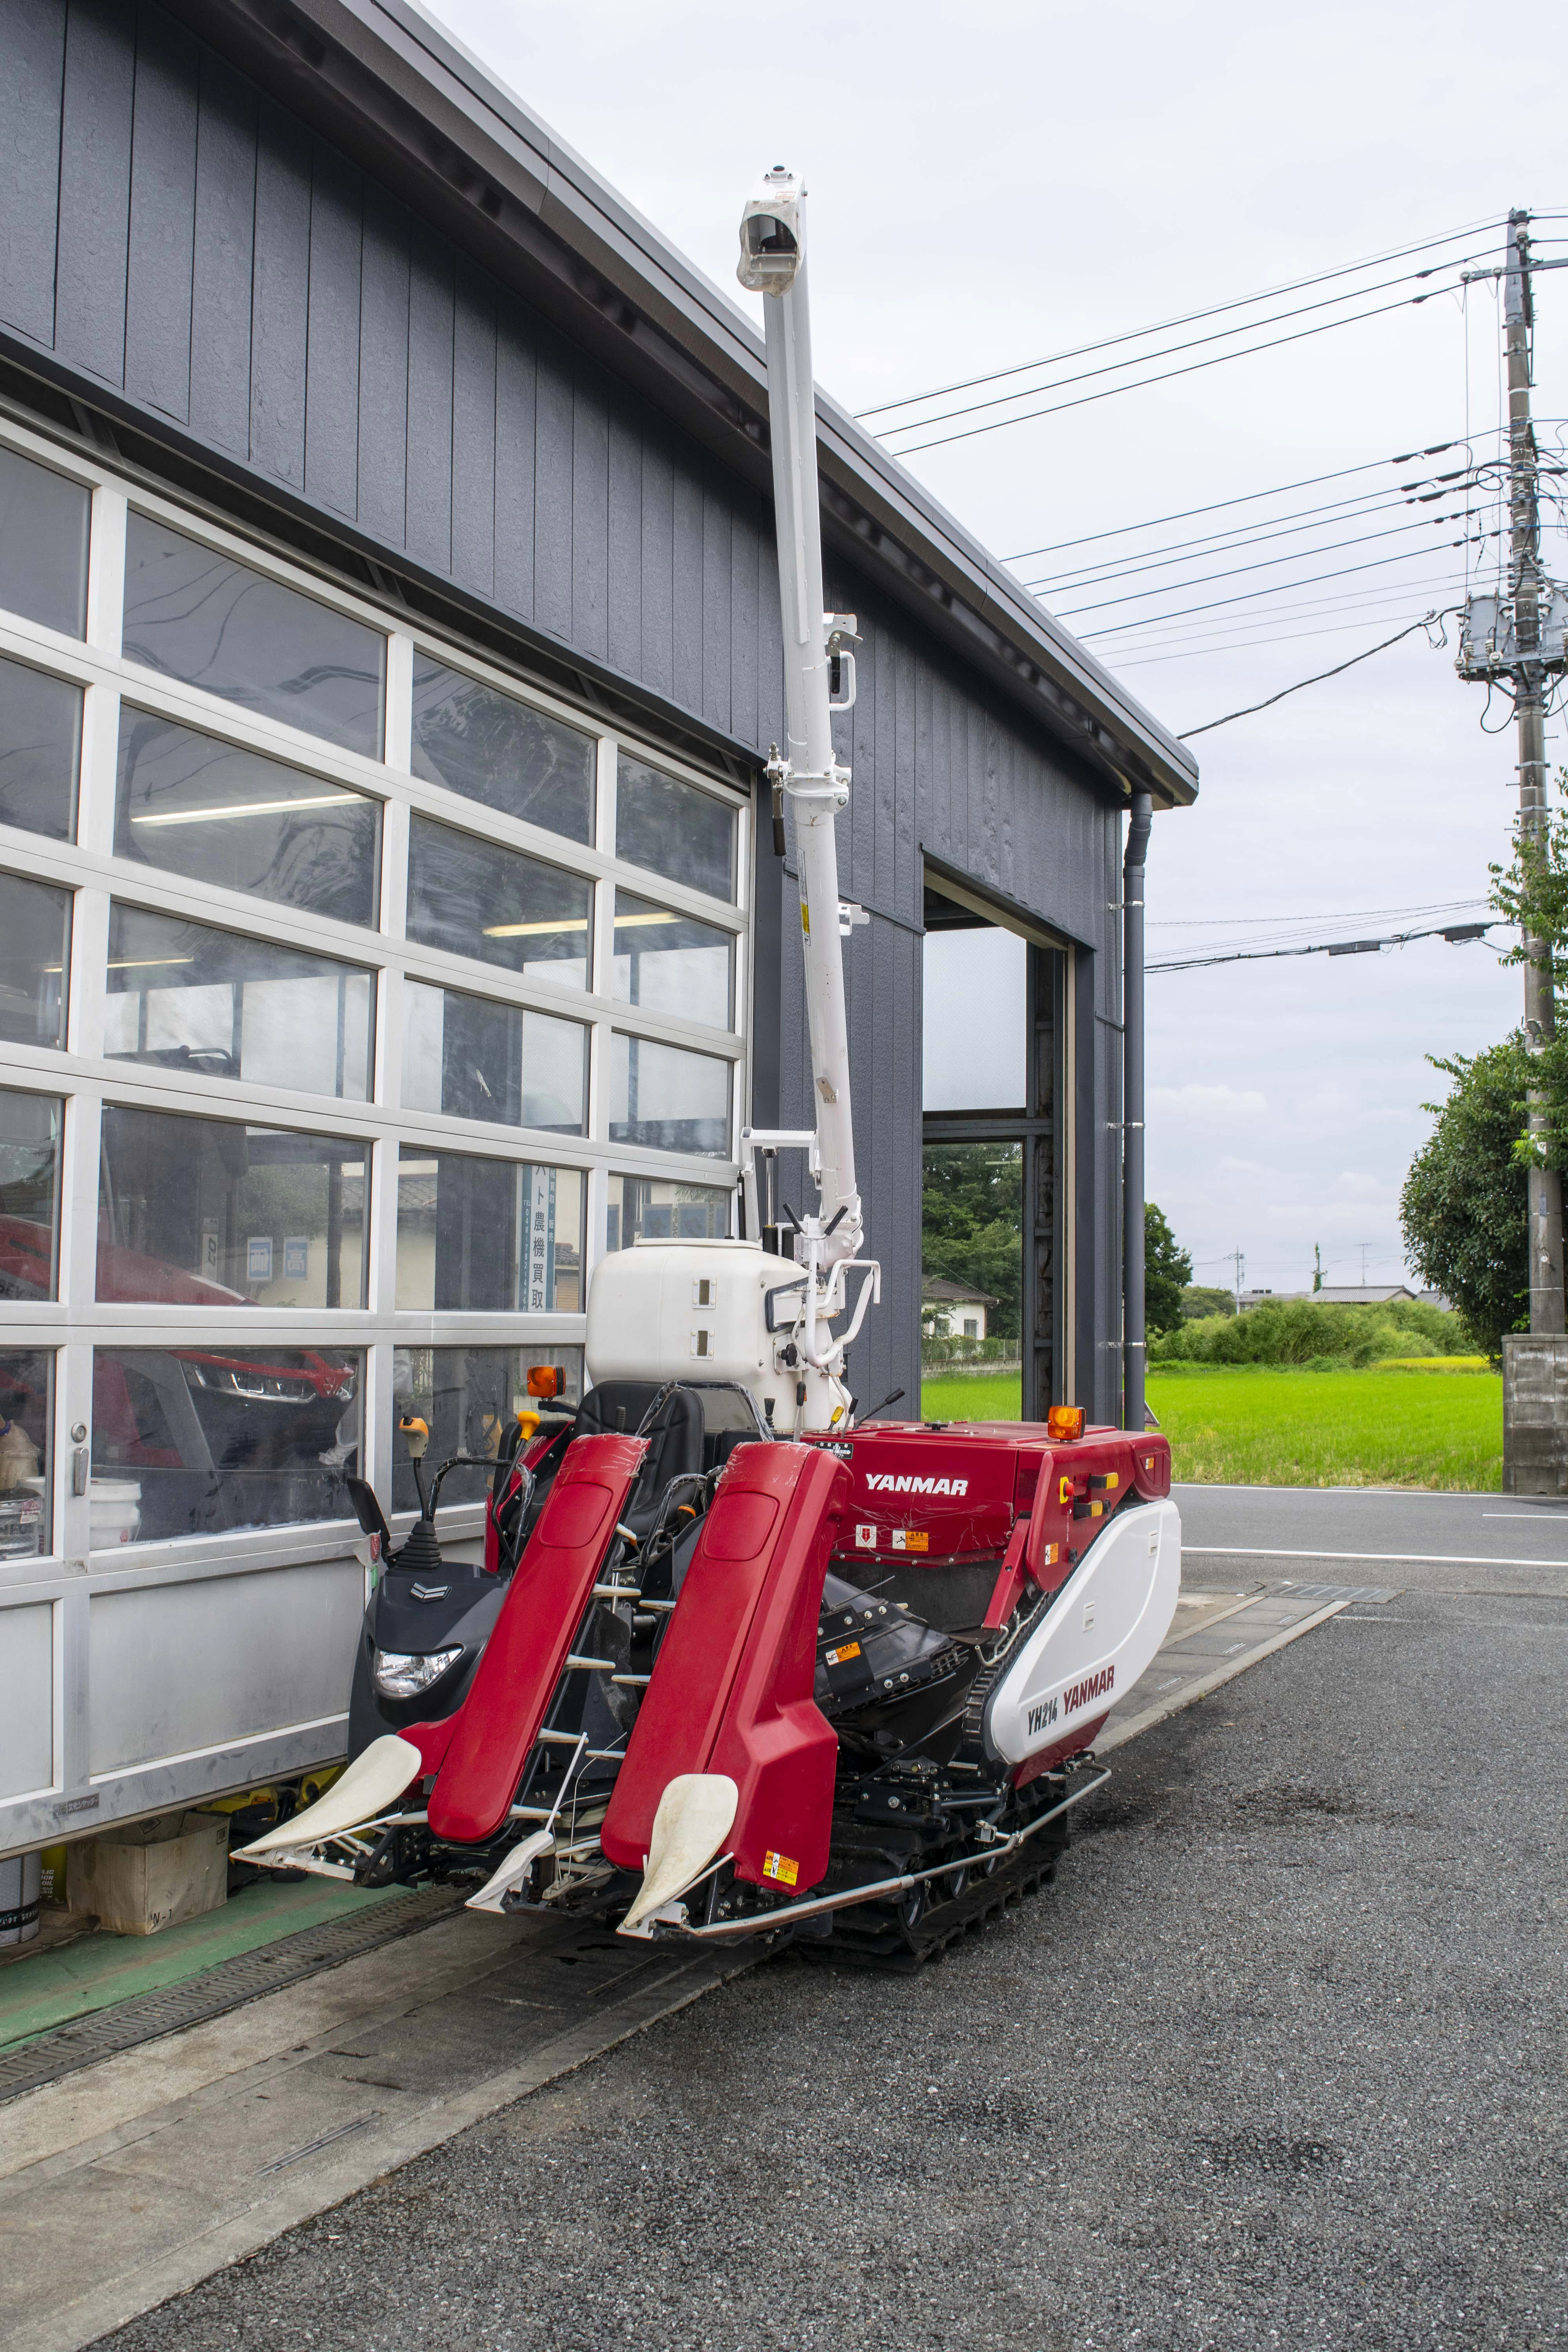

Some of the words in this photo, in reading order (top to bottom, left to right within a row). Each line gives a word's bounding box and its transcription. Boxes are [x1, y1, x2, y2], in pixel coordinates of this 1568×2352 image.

[866, 1474, 968, 1496] YANMAR
[1028, 1697, 1058, 1736] YH214
[1063, 1665, 1114, 1716] YANMAR
